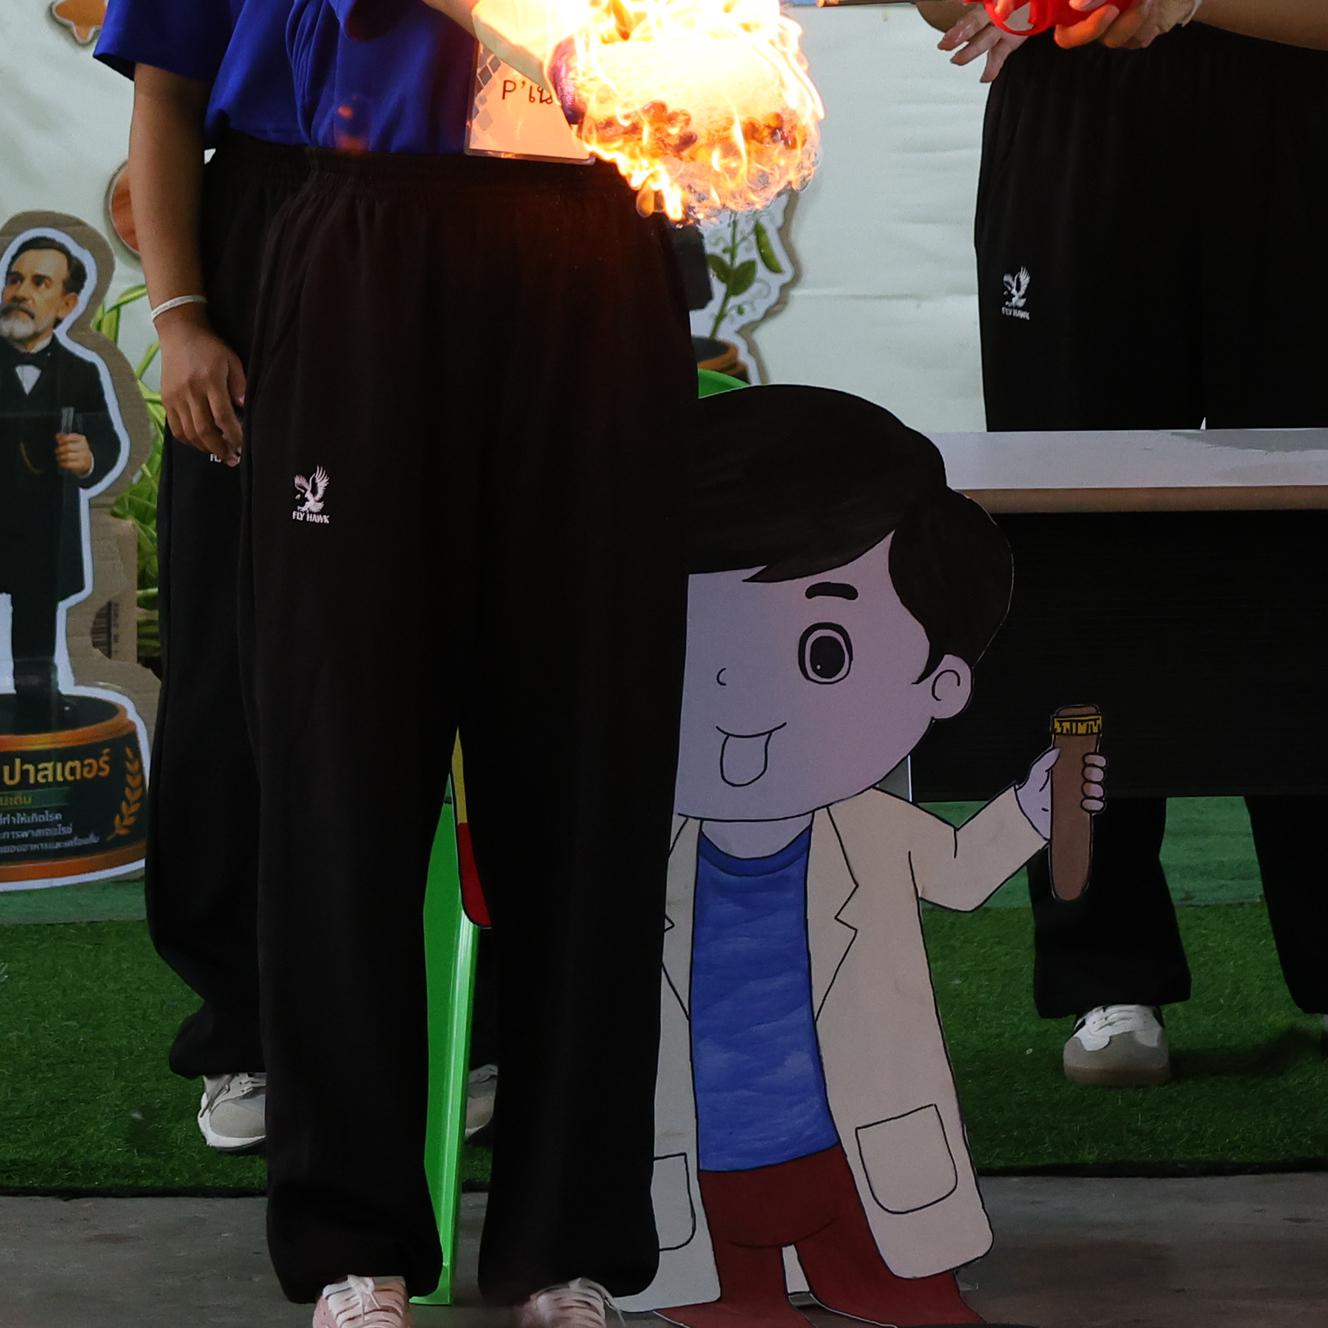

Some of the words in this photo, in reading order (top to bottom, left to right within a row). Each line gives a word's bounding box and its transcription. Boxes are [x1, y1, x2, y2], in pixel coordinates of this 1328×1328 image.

[292, 510, 305, 521] FLY
[306, 512, 330, 524] HAWK
[3, 748, 112, 786] ปาสเตอร์
